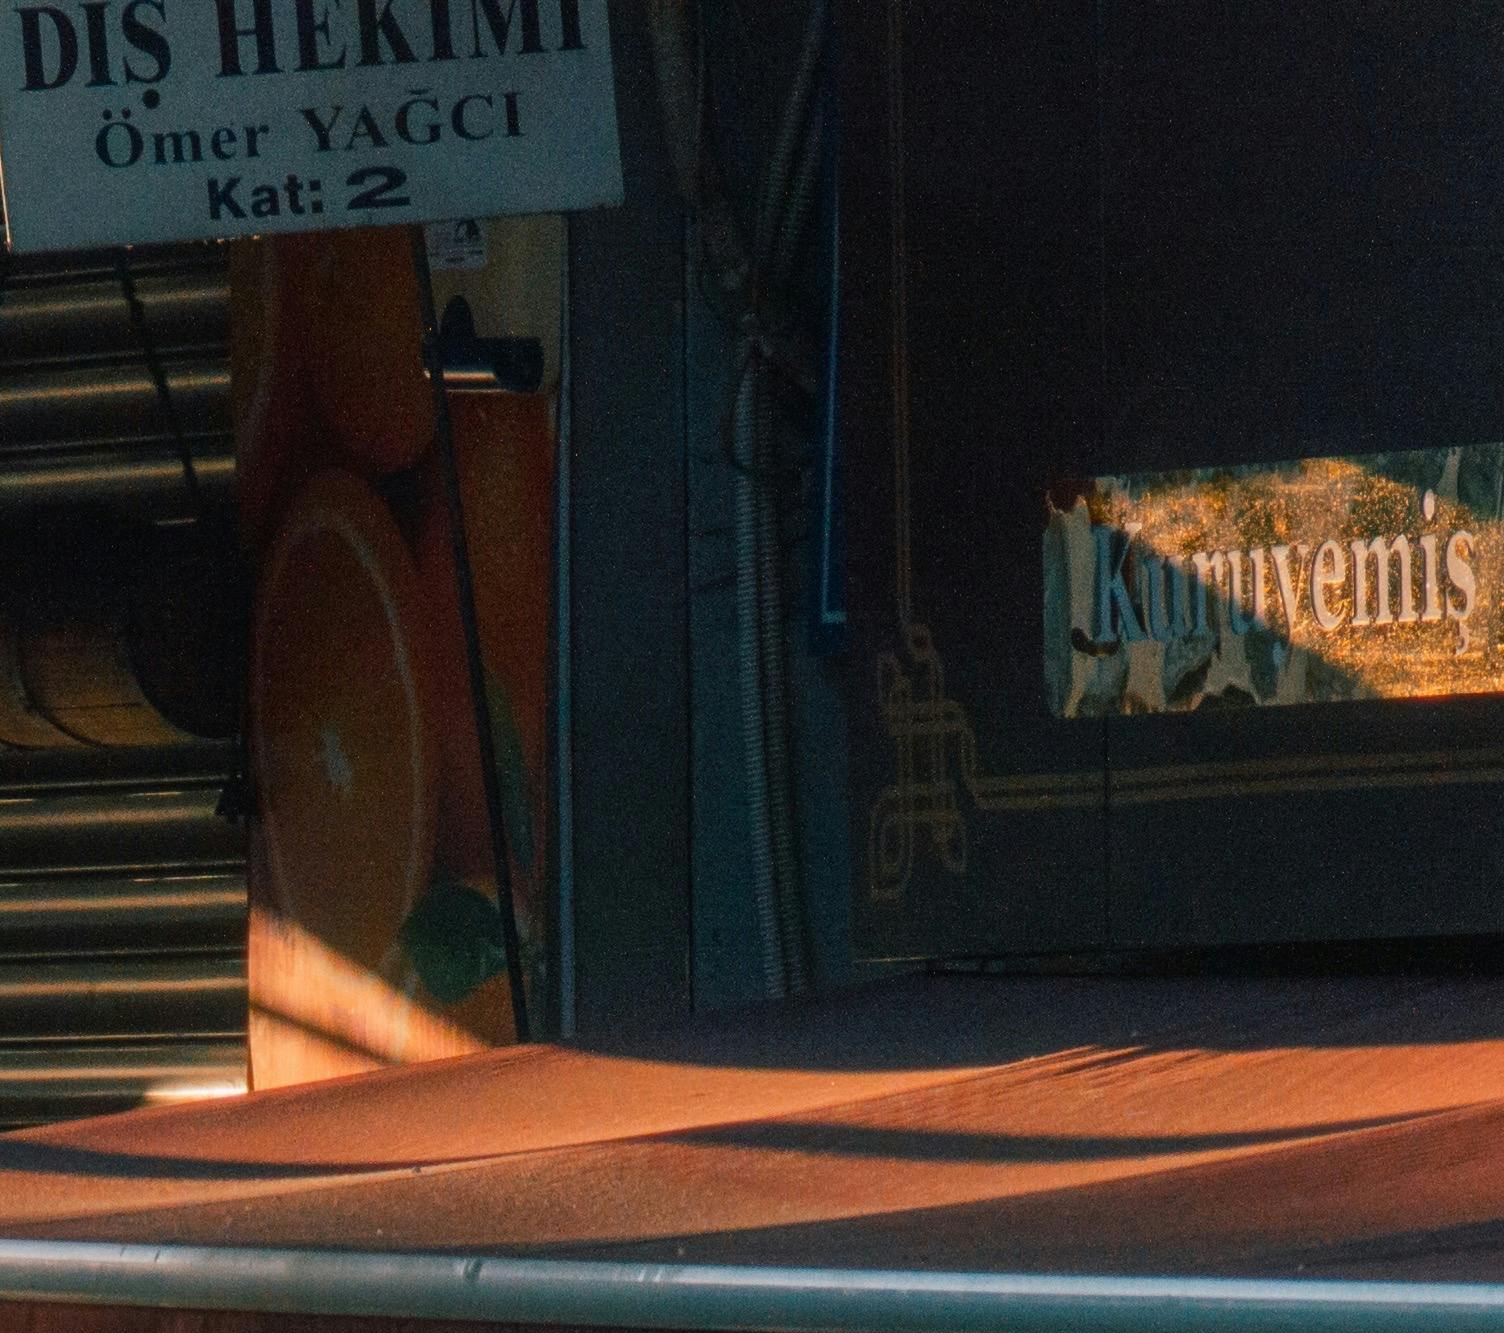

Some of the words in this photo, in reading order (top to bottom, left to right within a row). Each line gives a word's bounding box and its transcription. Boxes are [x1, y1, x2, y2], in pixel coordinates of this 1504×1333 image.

[94, 107, 271, 169] Ömer
[301, 88, 525, 153] YAĞCI
[207, 174, 325, 219] Kat:
[346, 165, 411, 210] 2
[1090, 487, 1478, 655] Kuruyemiş
